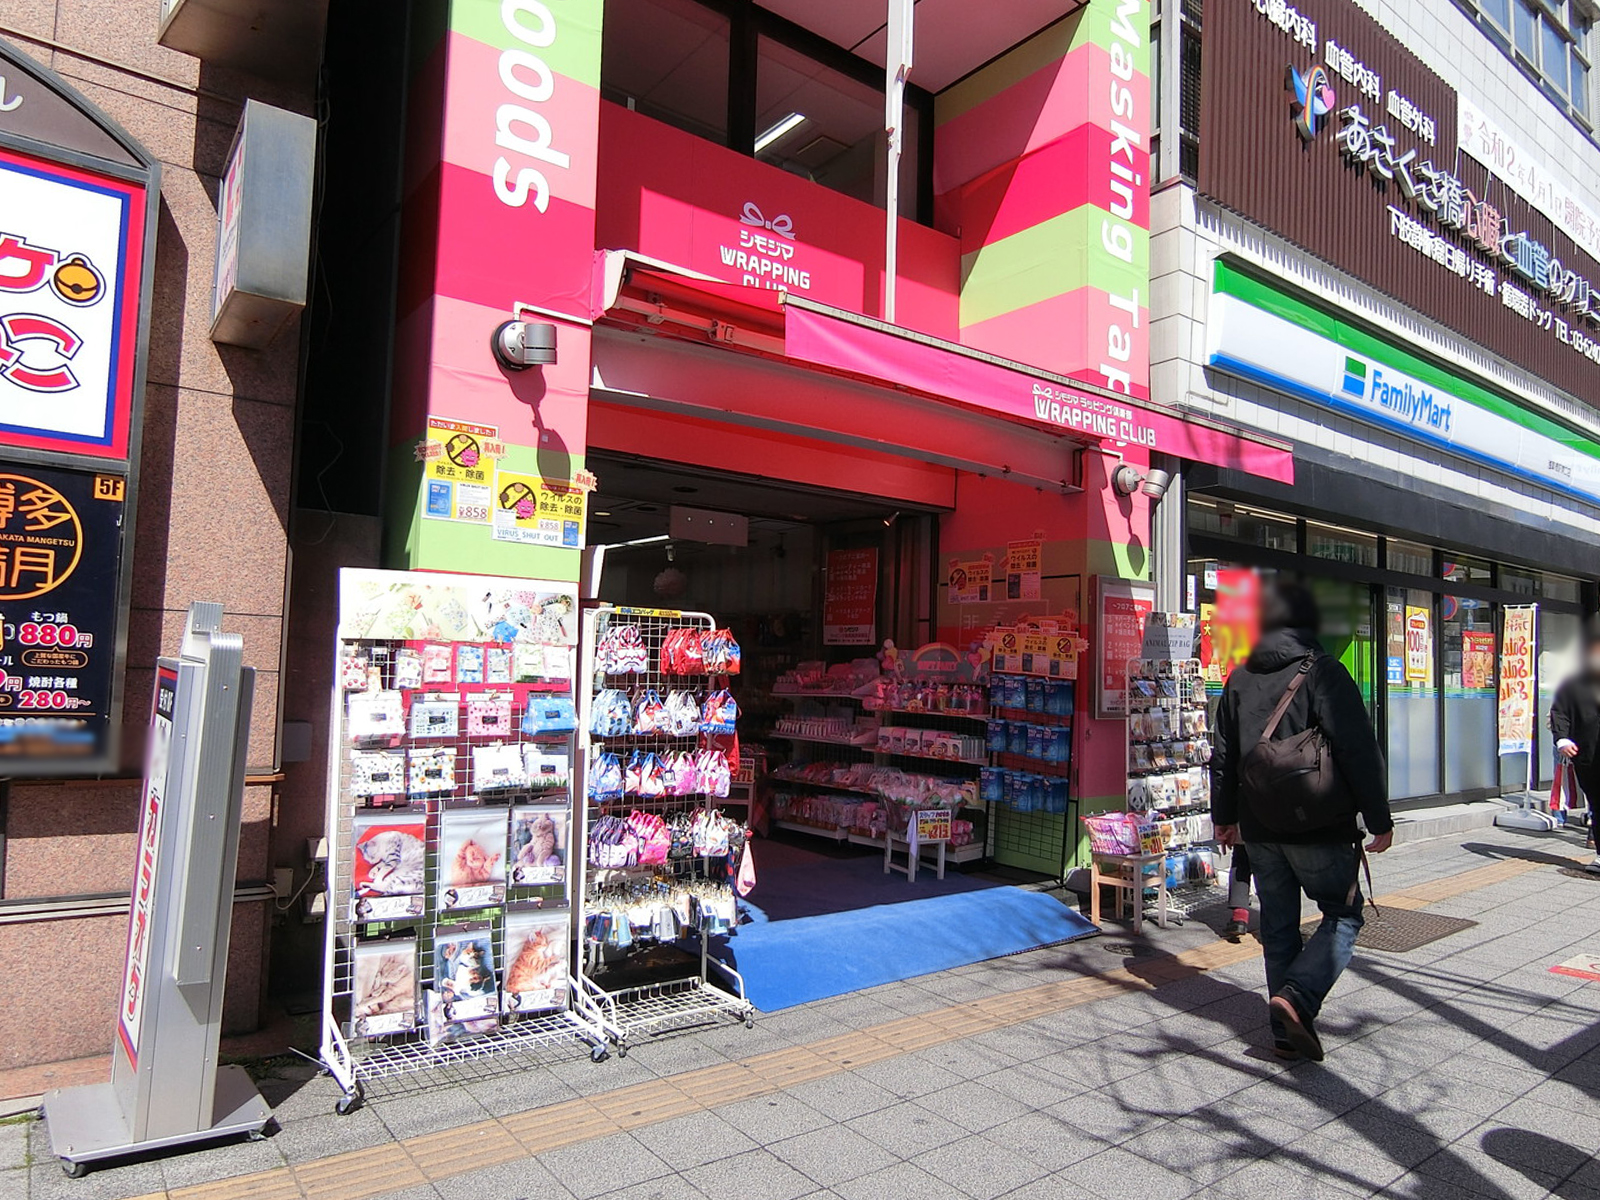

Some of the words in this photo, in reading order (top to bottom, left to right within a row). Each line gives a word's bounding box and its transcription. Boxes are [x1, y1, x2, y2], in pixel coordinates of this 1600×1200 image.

[1325, 40, 1380, 104] 血管内科
[1387, 90, 1435, 147] 血管外科
[740, 230, 794, 260] シモジマ
[720, 245, 810, 289] WRAPPING
[1370, 369, 1451, 432] FamilyMart
[1034, 395, 1116, 437] WRAPPING
[1119, 421, 1156, 446] CLUB
[436, 465, 485, 480] 除去・除菌
[100, 478, 121, 495] 5F
[540, 492, 583, 505] ウイルスの
[540, 501, 583, 516] 除去・除菌
[26, 536, 75, 548] MANGETSU
[497, 528, 519, 537] VIRUS
[522, 532, 541, 540] SHUT
[543, 534, 559, 542] OUT
[31, 611, 69, 623] もつ鍋
[19, 622, 93, 648] 880円
[1145, 639, 1168, 647] ANIMAL
[1179, 640, 1191, 648] BAG
[28, 676, 78, 689] 焼酎各種
